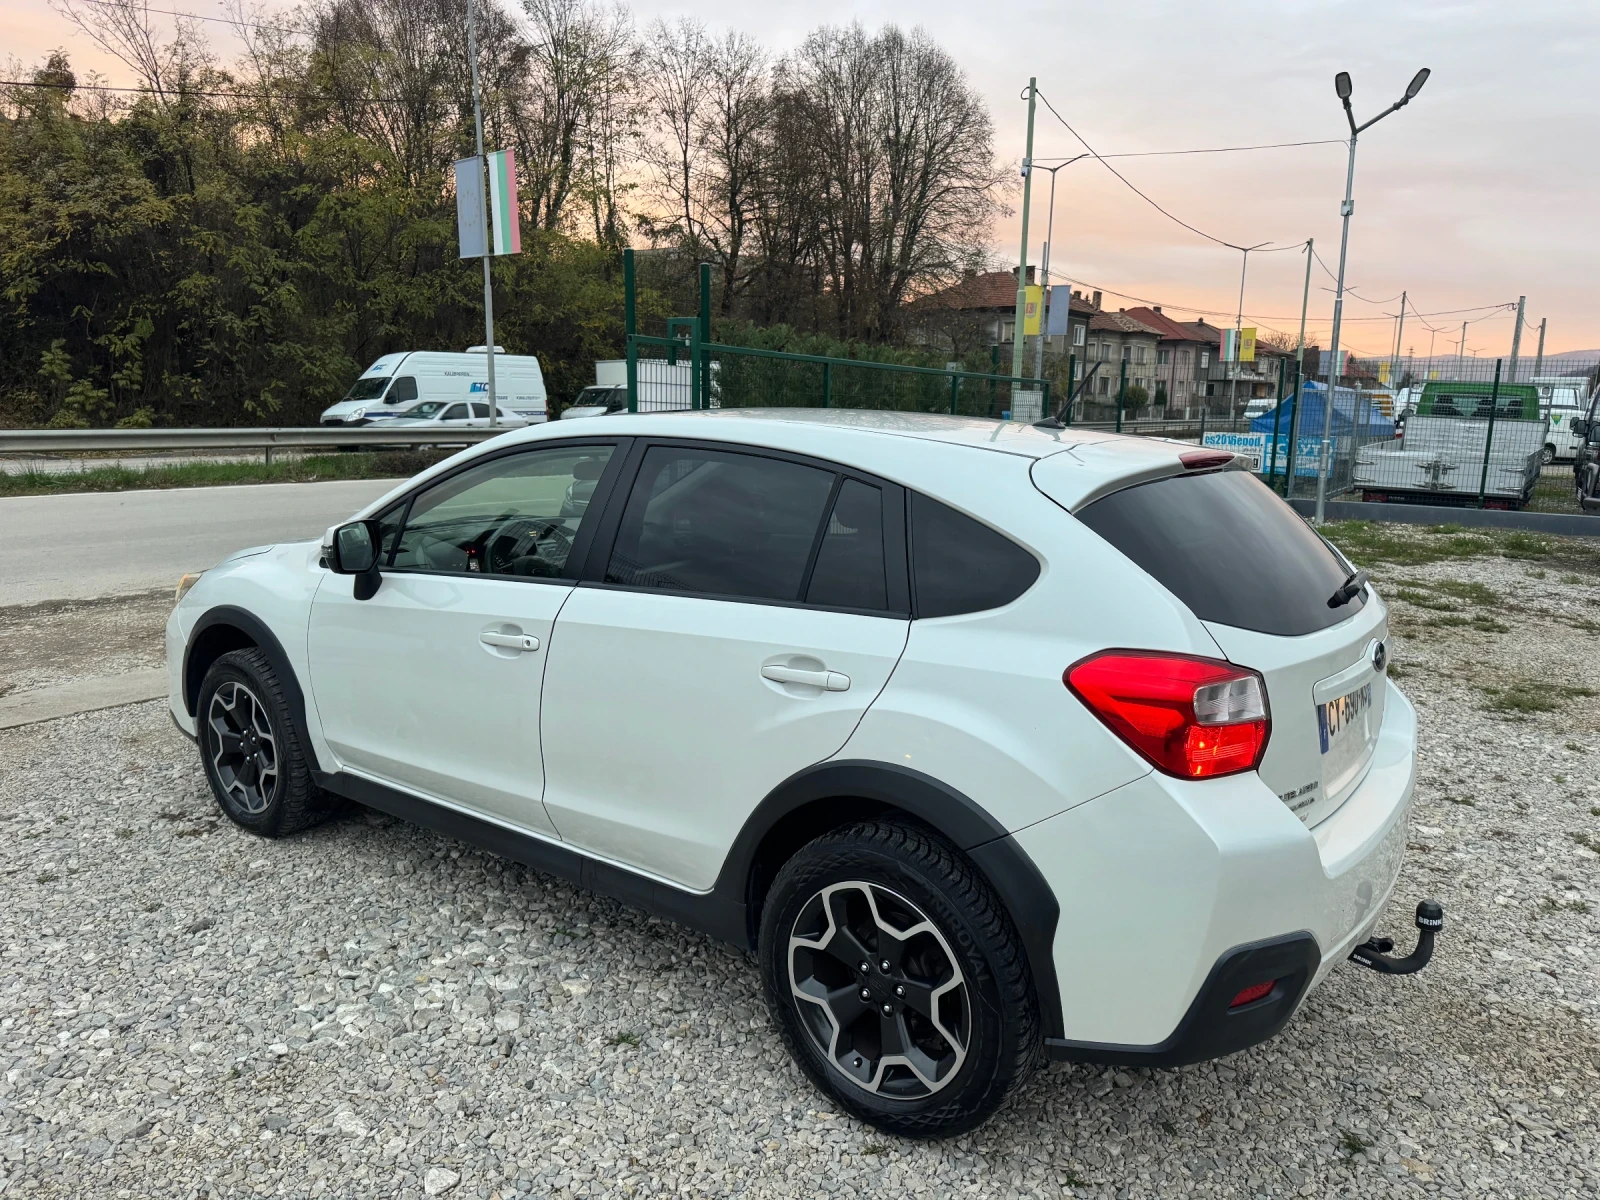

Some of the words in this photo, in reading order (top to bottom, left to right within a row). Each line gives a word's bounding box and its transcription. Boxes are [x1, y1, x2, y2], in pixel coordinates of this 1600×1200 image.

[1418, 915, 1442, 926] BRINK
[921, 889, 990, 989] NIROYAL
[1353, 953, 1373, 966] BRINK
